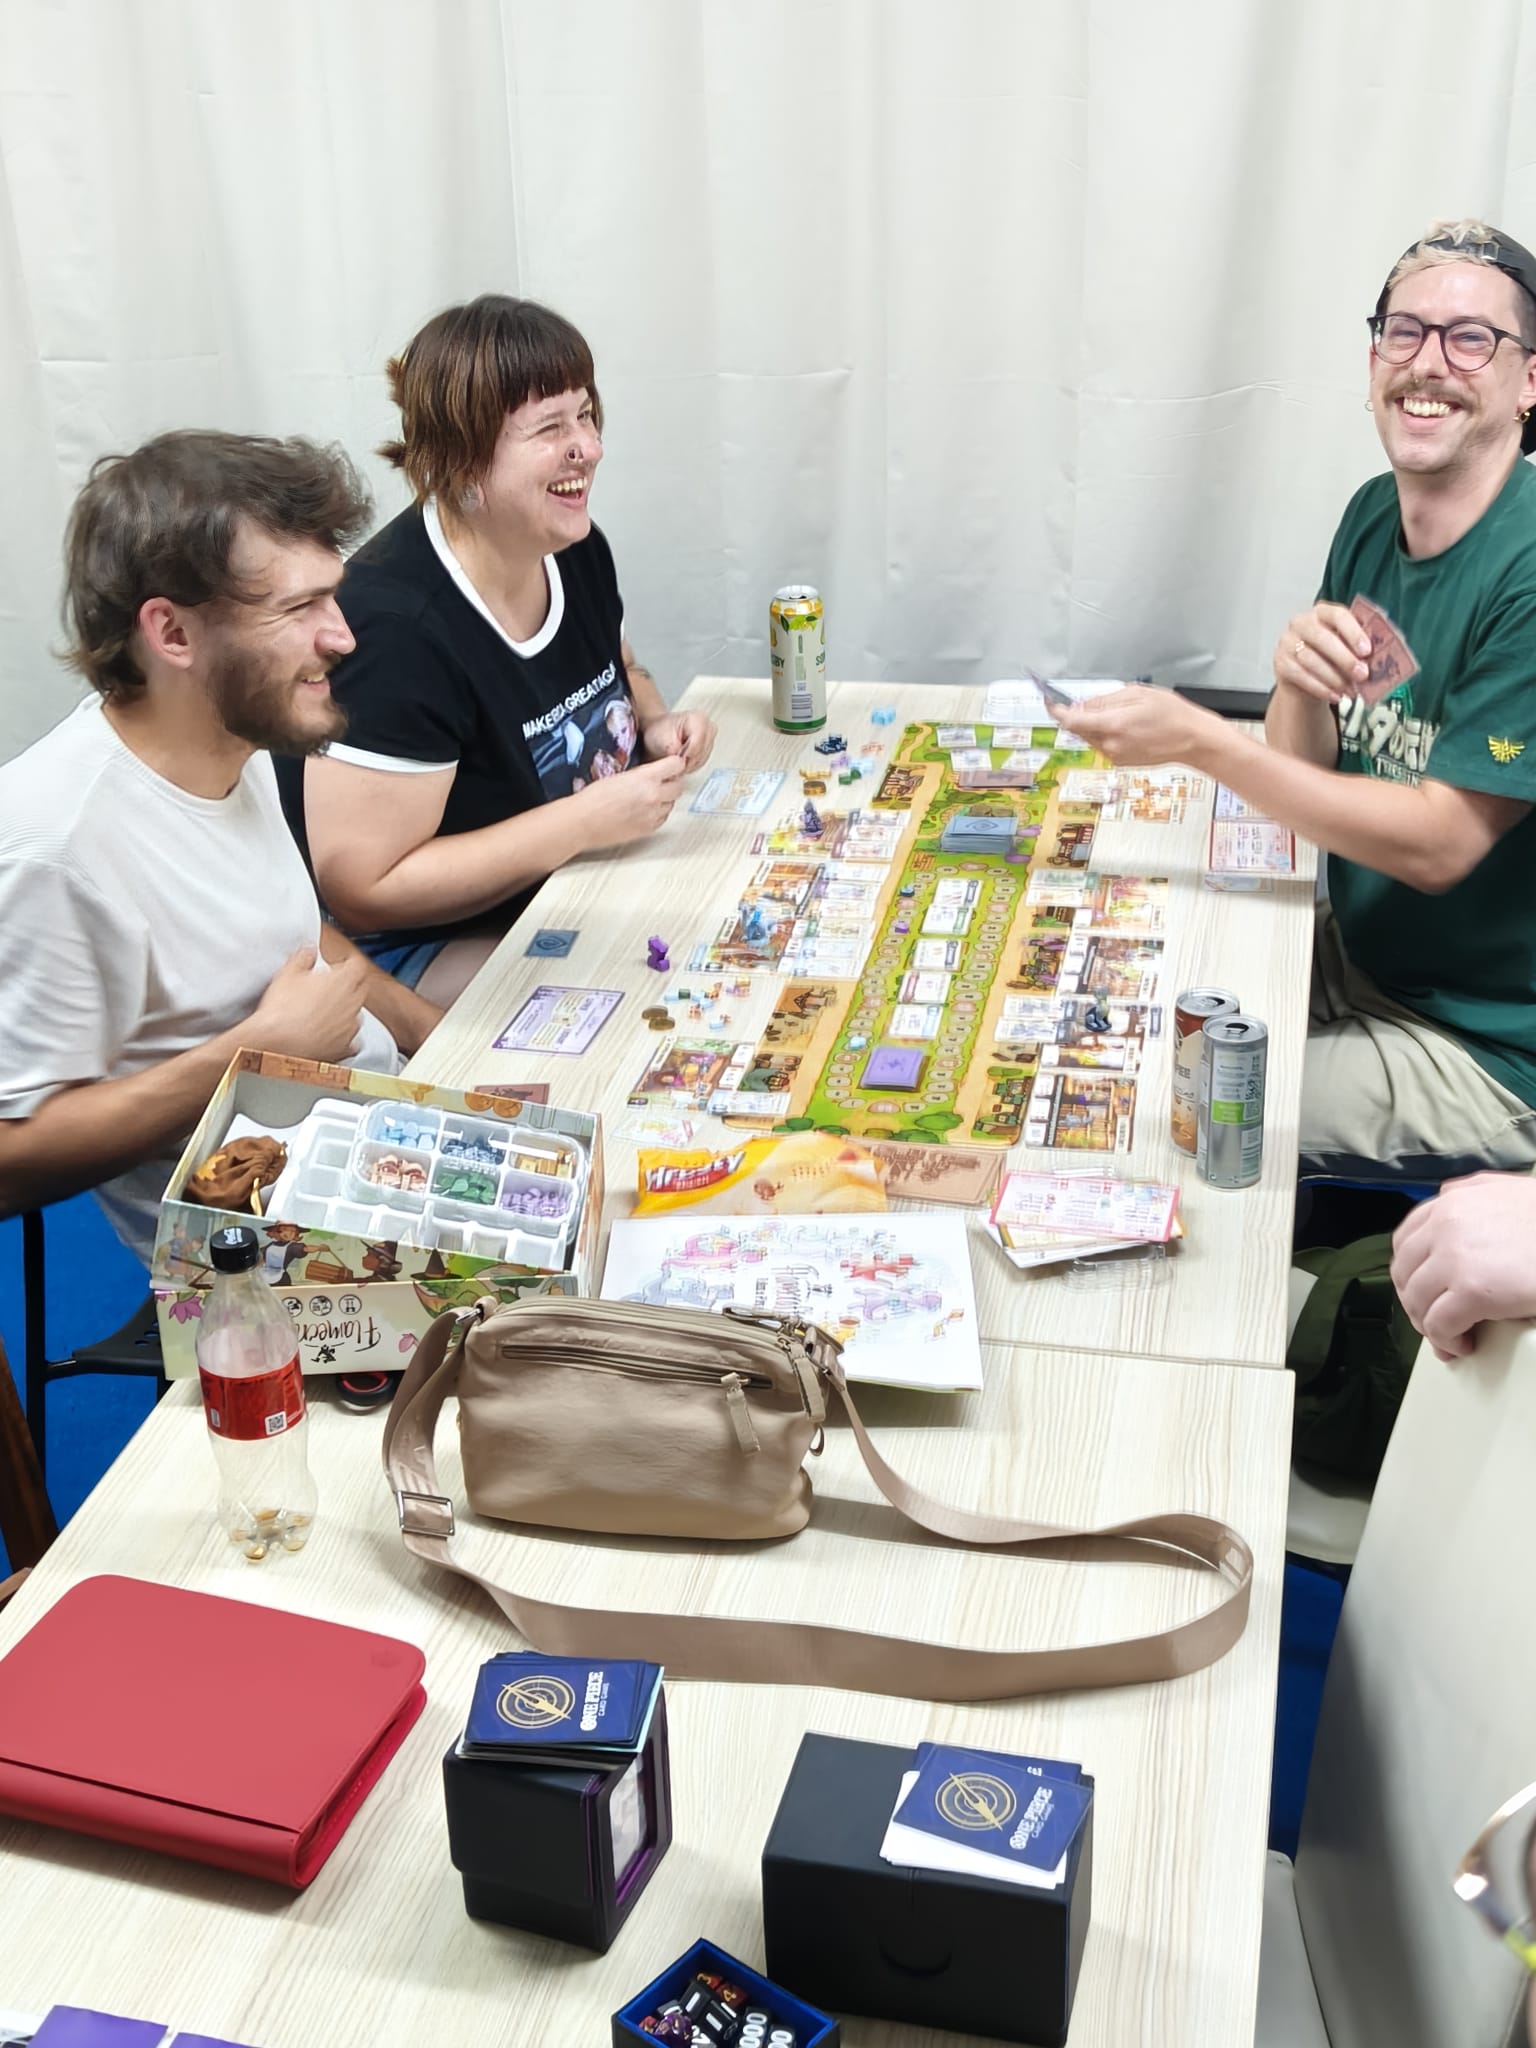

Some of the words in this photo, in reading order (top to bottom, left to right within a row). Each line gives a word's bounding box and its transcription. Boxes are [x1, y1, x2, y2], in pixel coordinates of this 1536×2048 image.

[584, 1671, 604, 1703] PIECE
[579, 1702, 598, 1731] ONE
[1010, 1818, 1035, 1849] ONE
[1024, 1786, 1053, 1822] PIECE
